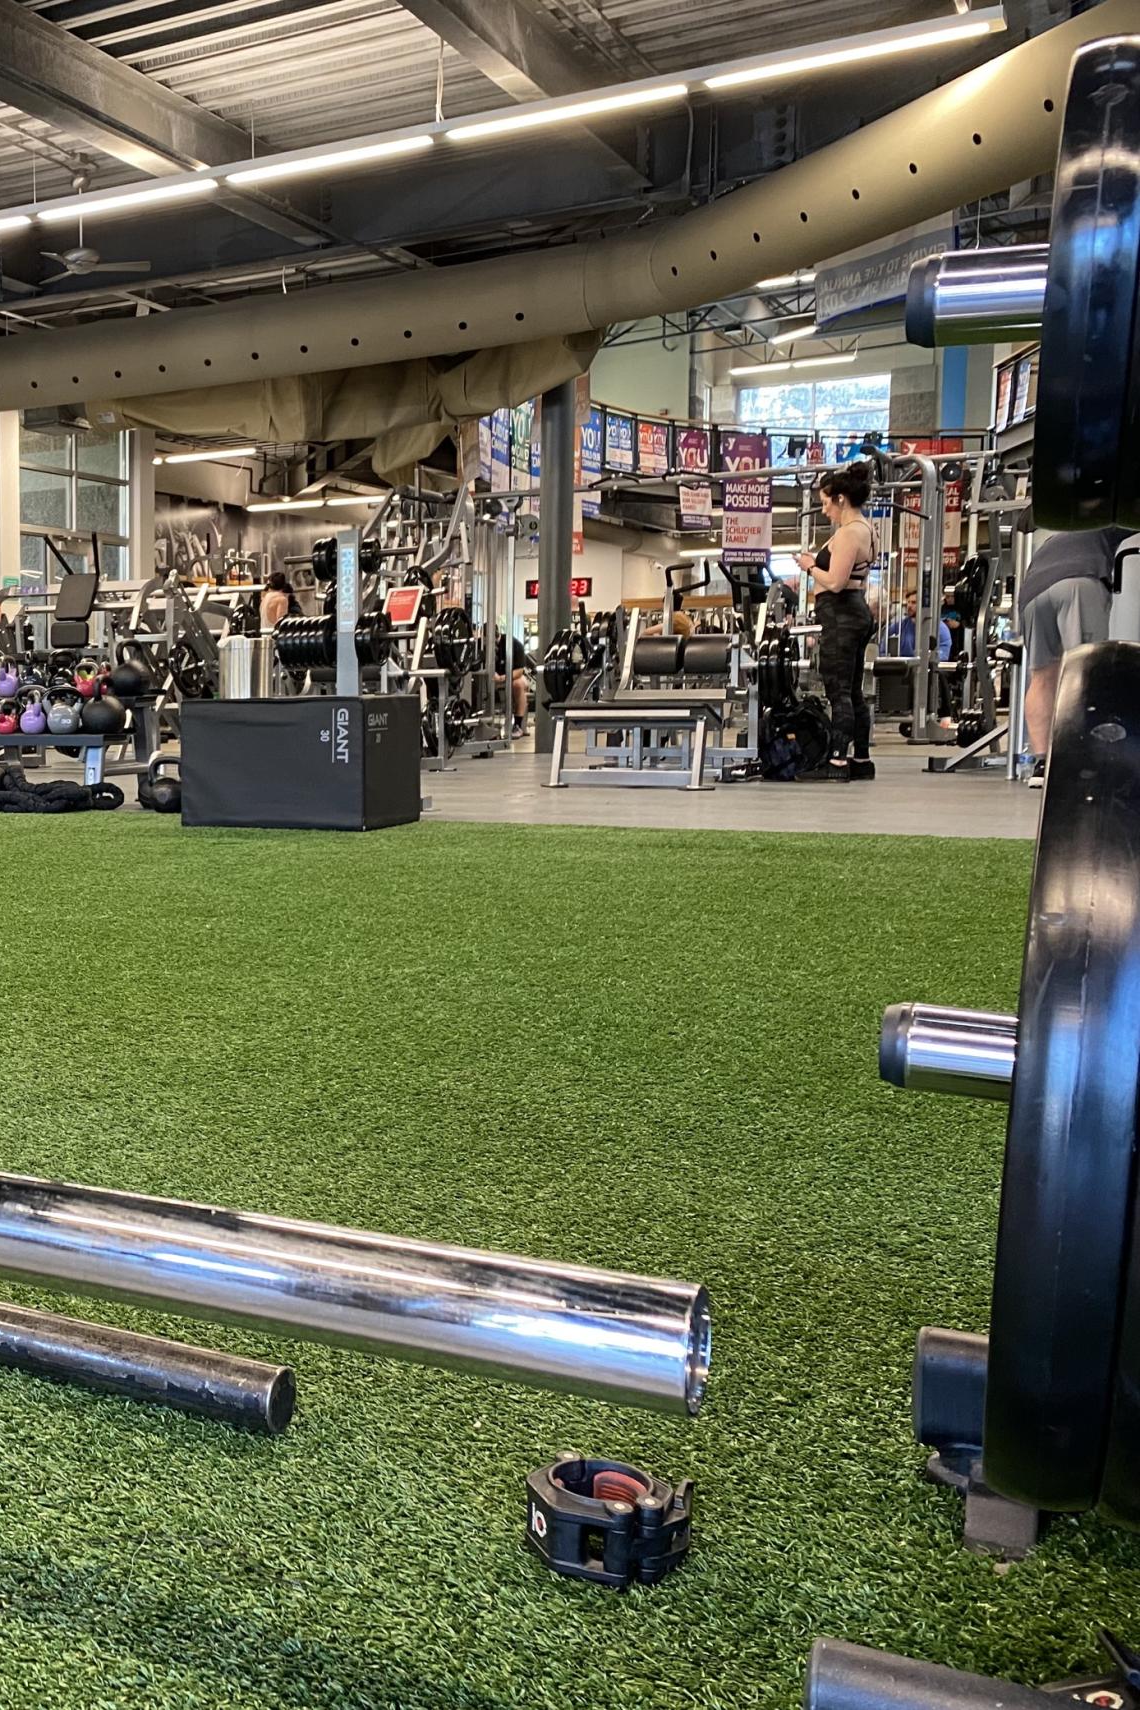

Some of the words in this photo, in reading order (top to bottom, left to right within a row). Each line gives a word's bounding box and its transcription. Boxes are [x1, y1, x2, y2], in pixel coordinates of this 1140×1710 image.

[679, 446, 709, 468] YOU
[725, 456, 770, 482] YOU
[726, 483, 747, 494] MAKE
[748, 483, 770, 495] MORE
[725, 495, 770, 508] POSSIBLE
[726, 517, 739, 525] THE
[725, 535, 749, 544] FAMILY
[367, 713, 389, 727] GIANT
[320, 729, 330, 742] 30
[336, 708, 349, 764] GIANT
